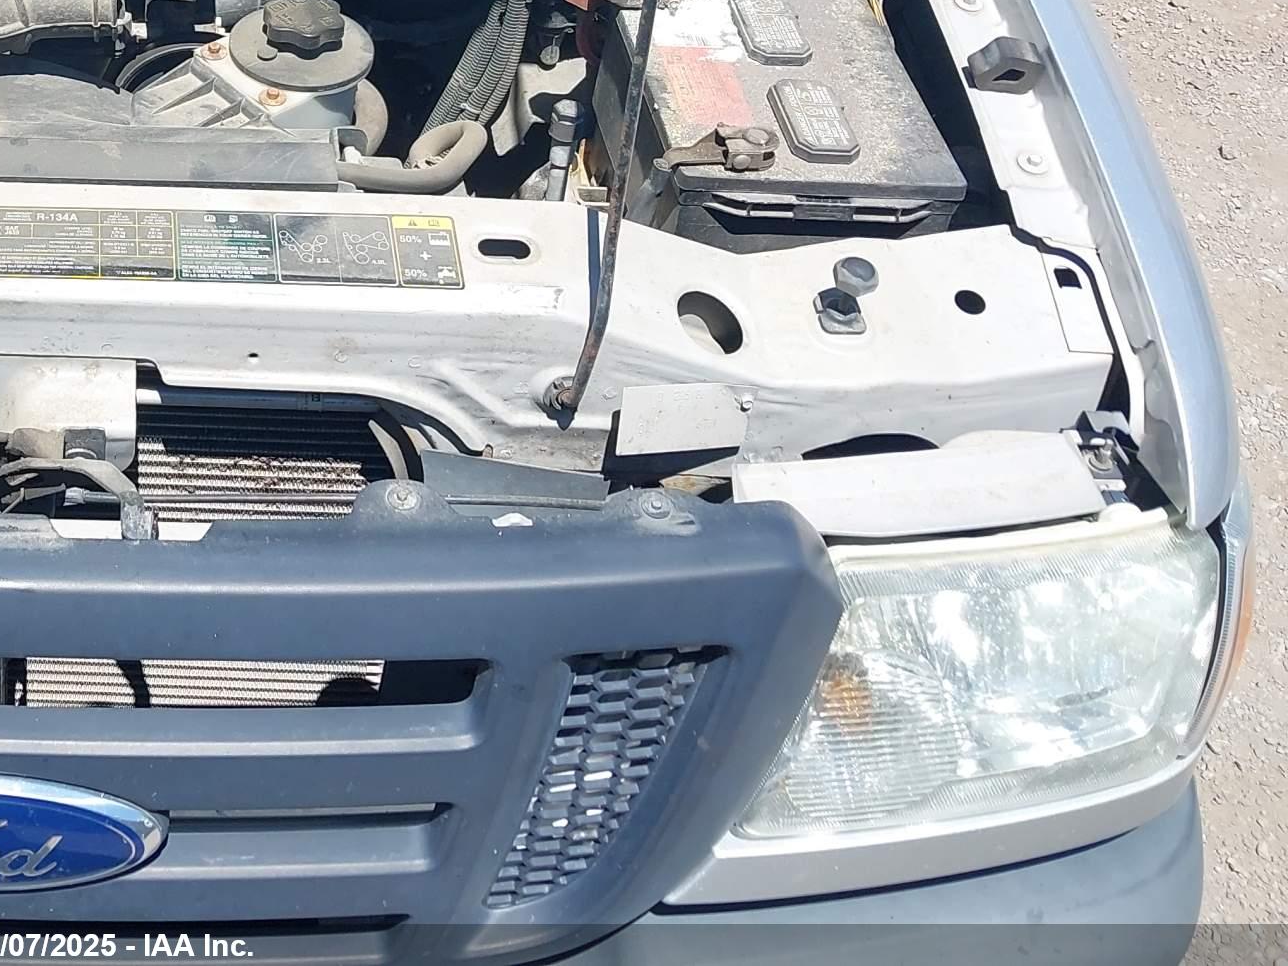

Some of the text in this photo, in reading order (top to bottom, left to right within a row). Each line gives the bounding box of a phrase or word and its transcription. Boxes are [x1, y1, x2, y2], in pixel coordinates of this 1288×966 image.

[36, 212, 78, 222] R-134A
[399, 235, 423, 244] 50%
[404, 268, 428, 278] 50%
